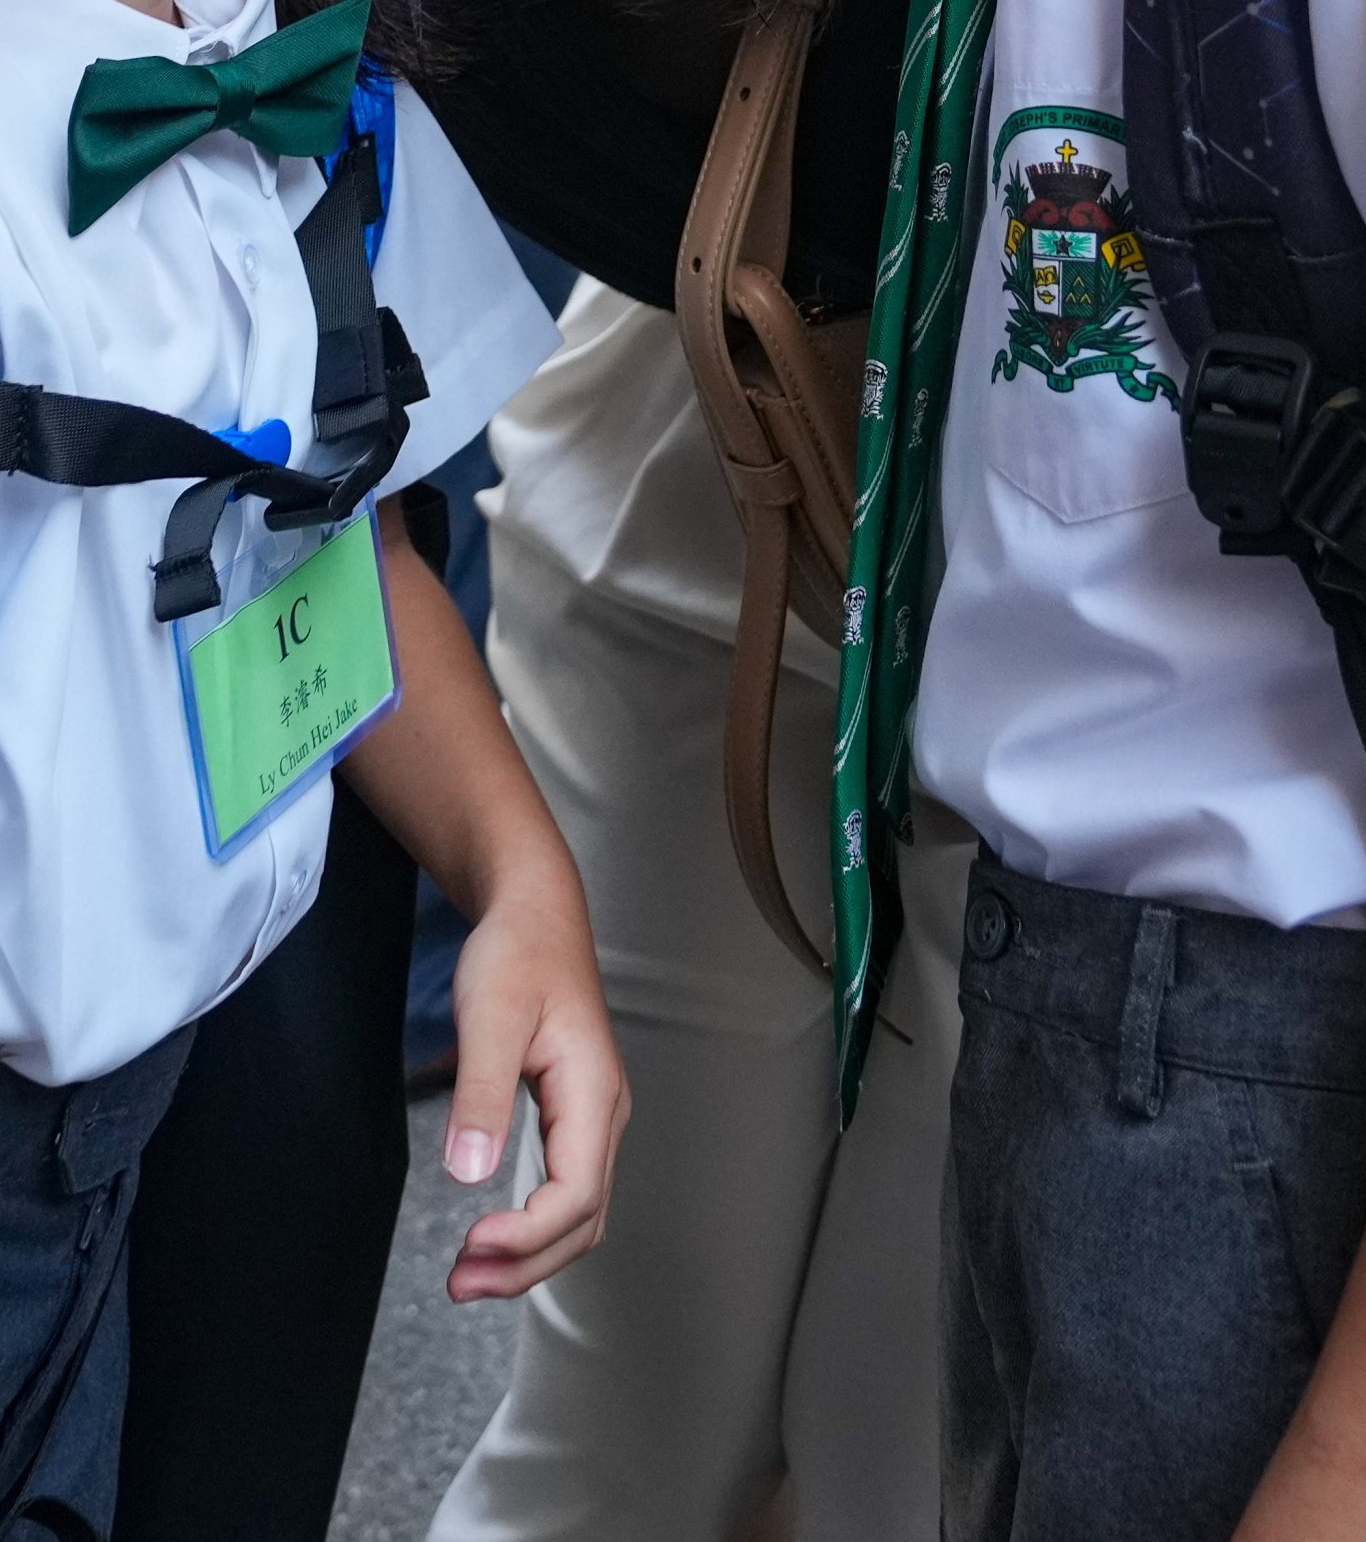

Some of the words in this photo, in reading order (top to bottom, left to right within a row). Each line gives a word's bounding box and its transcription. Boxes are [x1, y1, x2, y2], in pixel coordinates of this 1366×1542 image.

[1073, 357, 1125, 377] VIRTUTE
[273, 592, 312, 664] 1C
[280, 663, 327, 727] 李濬希
[259, 769, 276, 795] Ly
[280, 743, 309, 777] Chun
[311, 716, 333, 749] Hei
[335, 697, 358, 730] Jake
